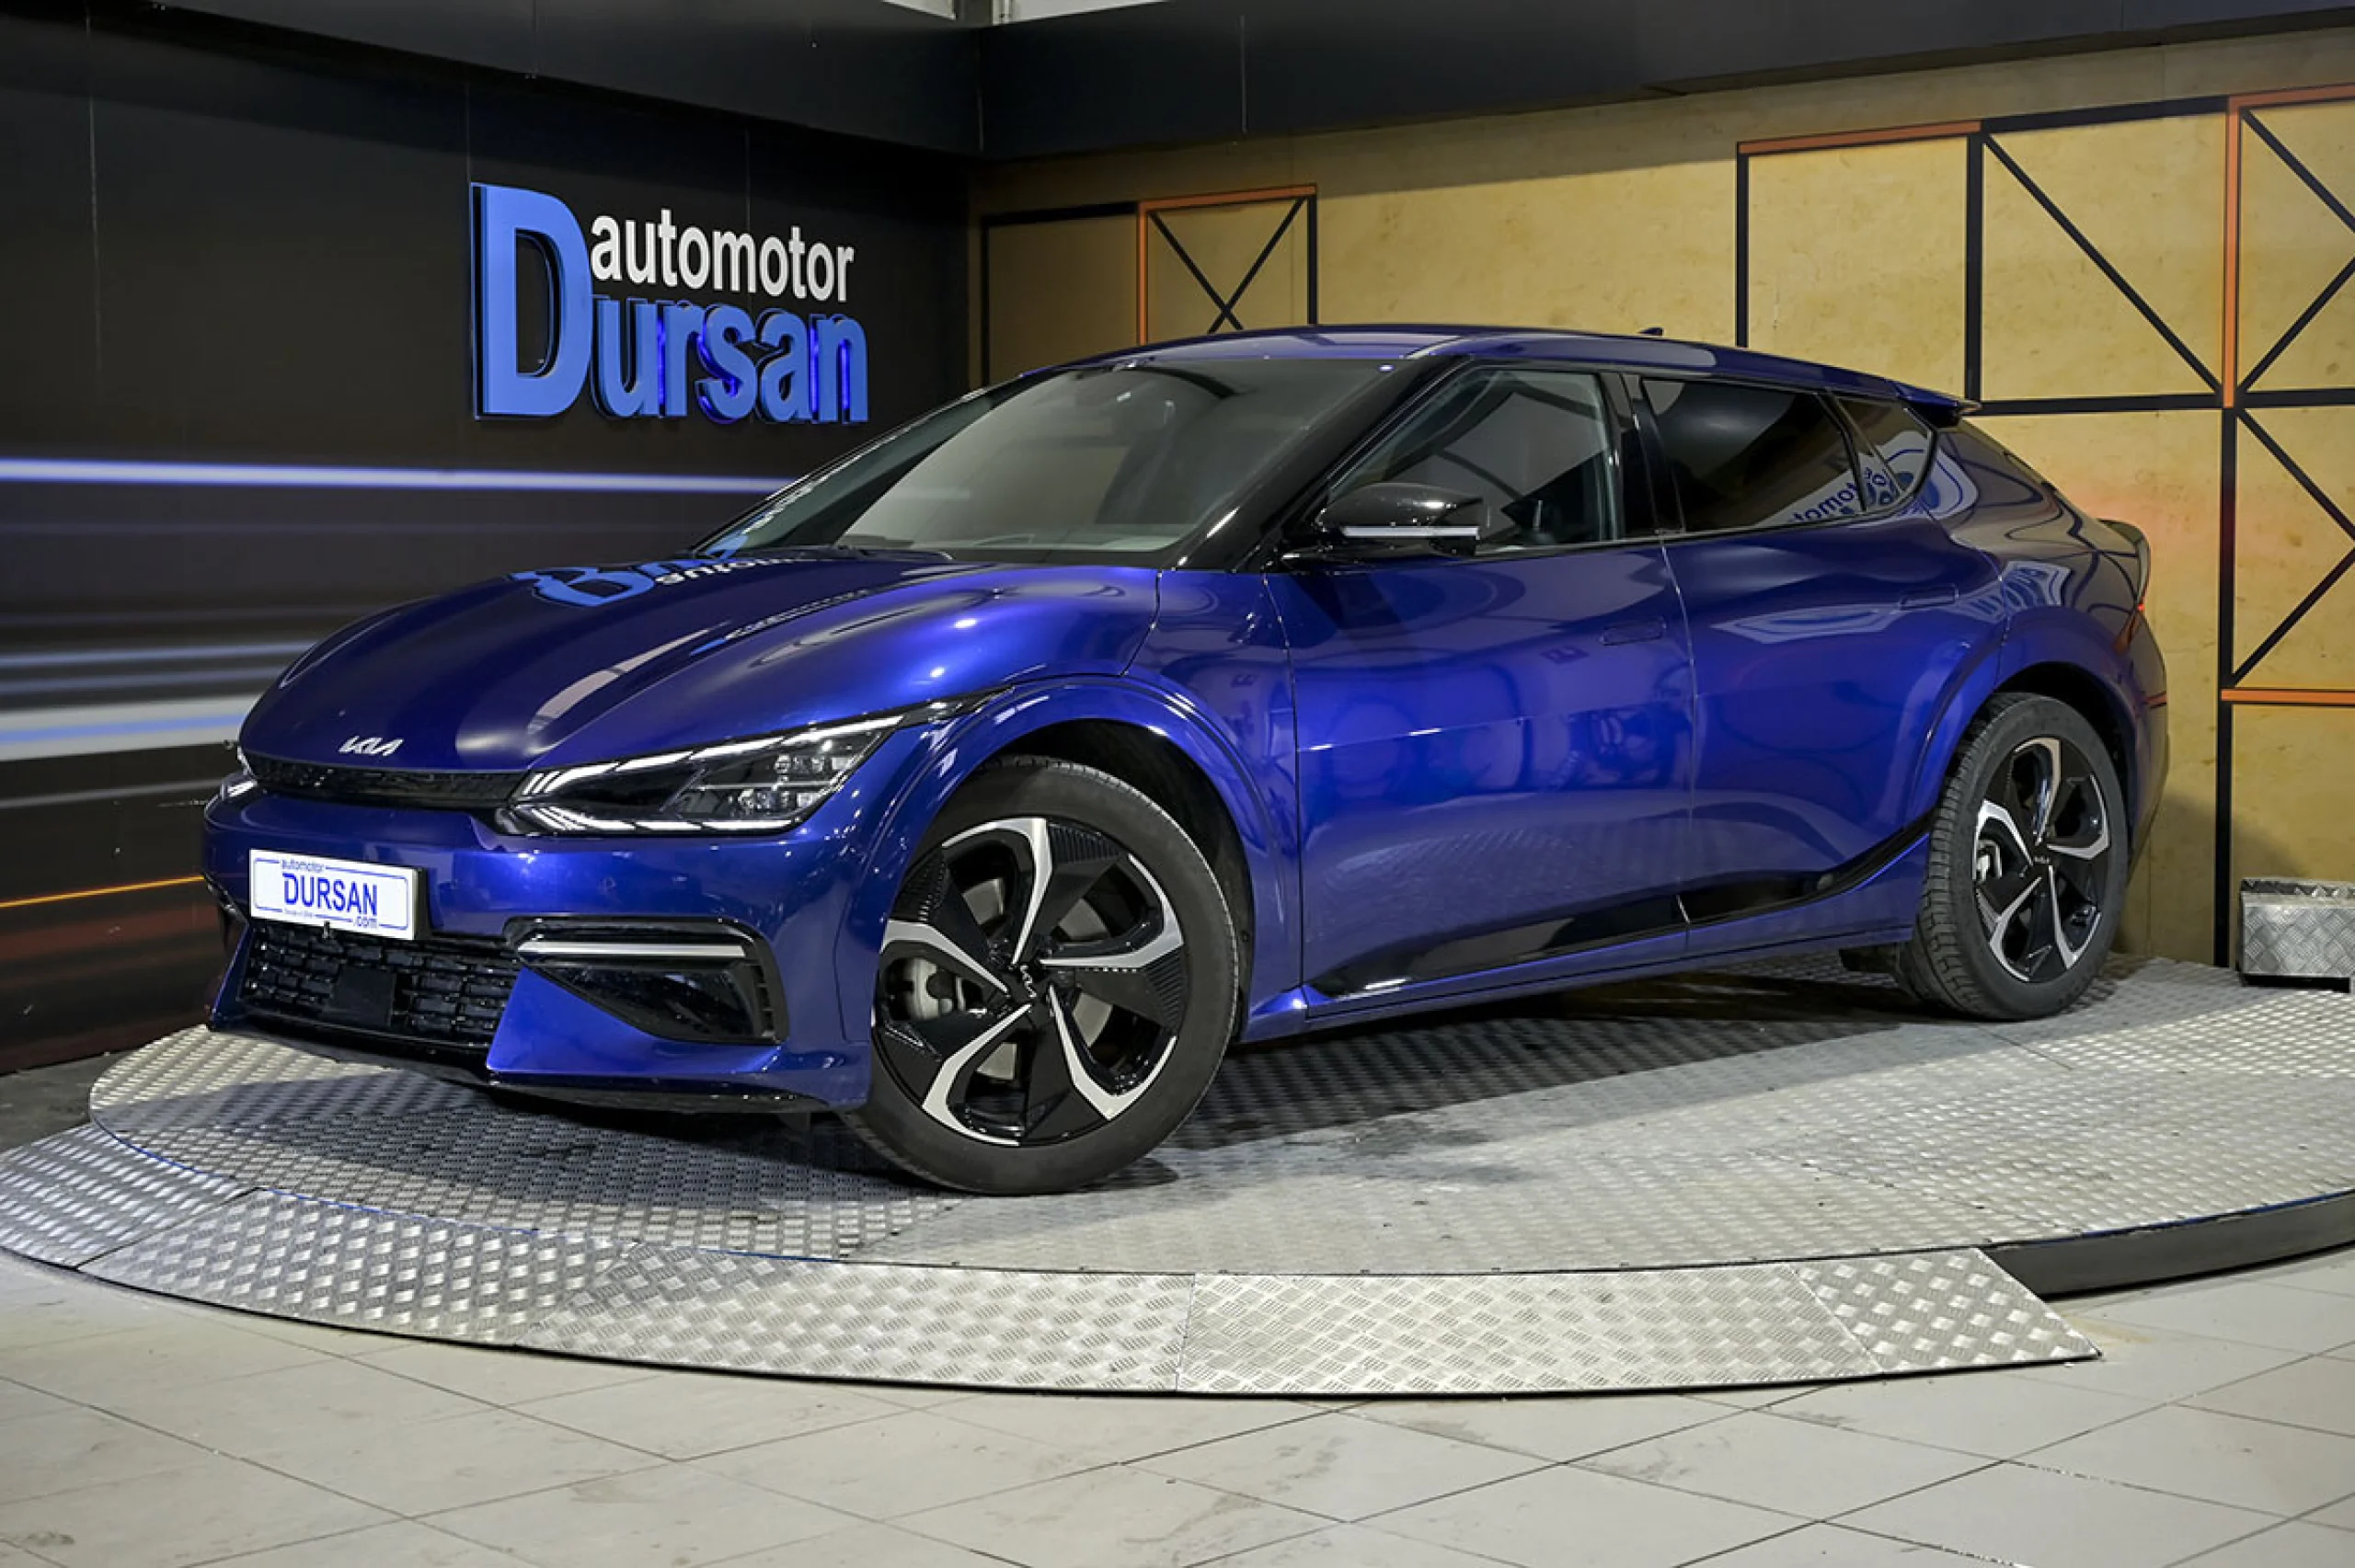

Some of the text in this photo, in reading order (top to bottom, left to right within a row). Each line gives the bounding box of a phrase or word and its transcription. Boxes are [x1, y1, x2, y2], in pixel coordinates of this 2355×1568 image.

[590, 209, 855, 302] automotor
[470, 182, 868, 424] Dursan
[338, 736, 404, 756] KIA
[282, 873, 377, 916] DURSAN
